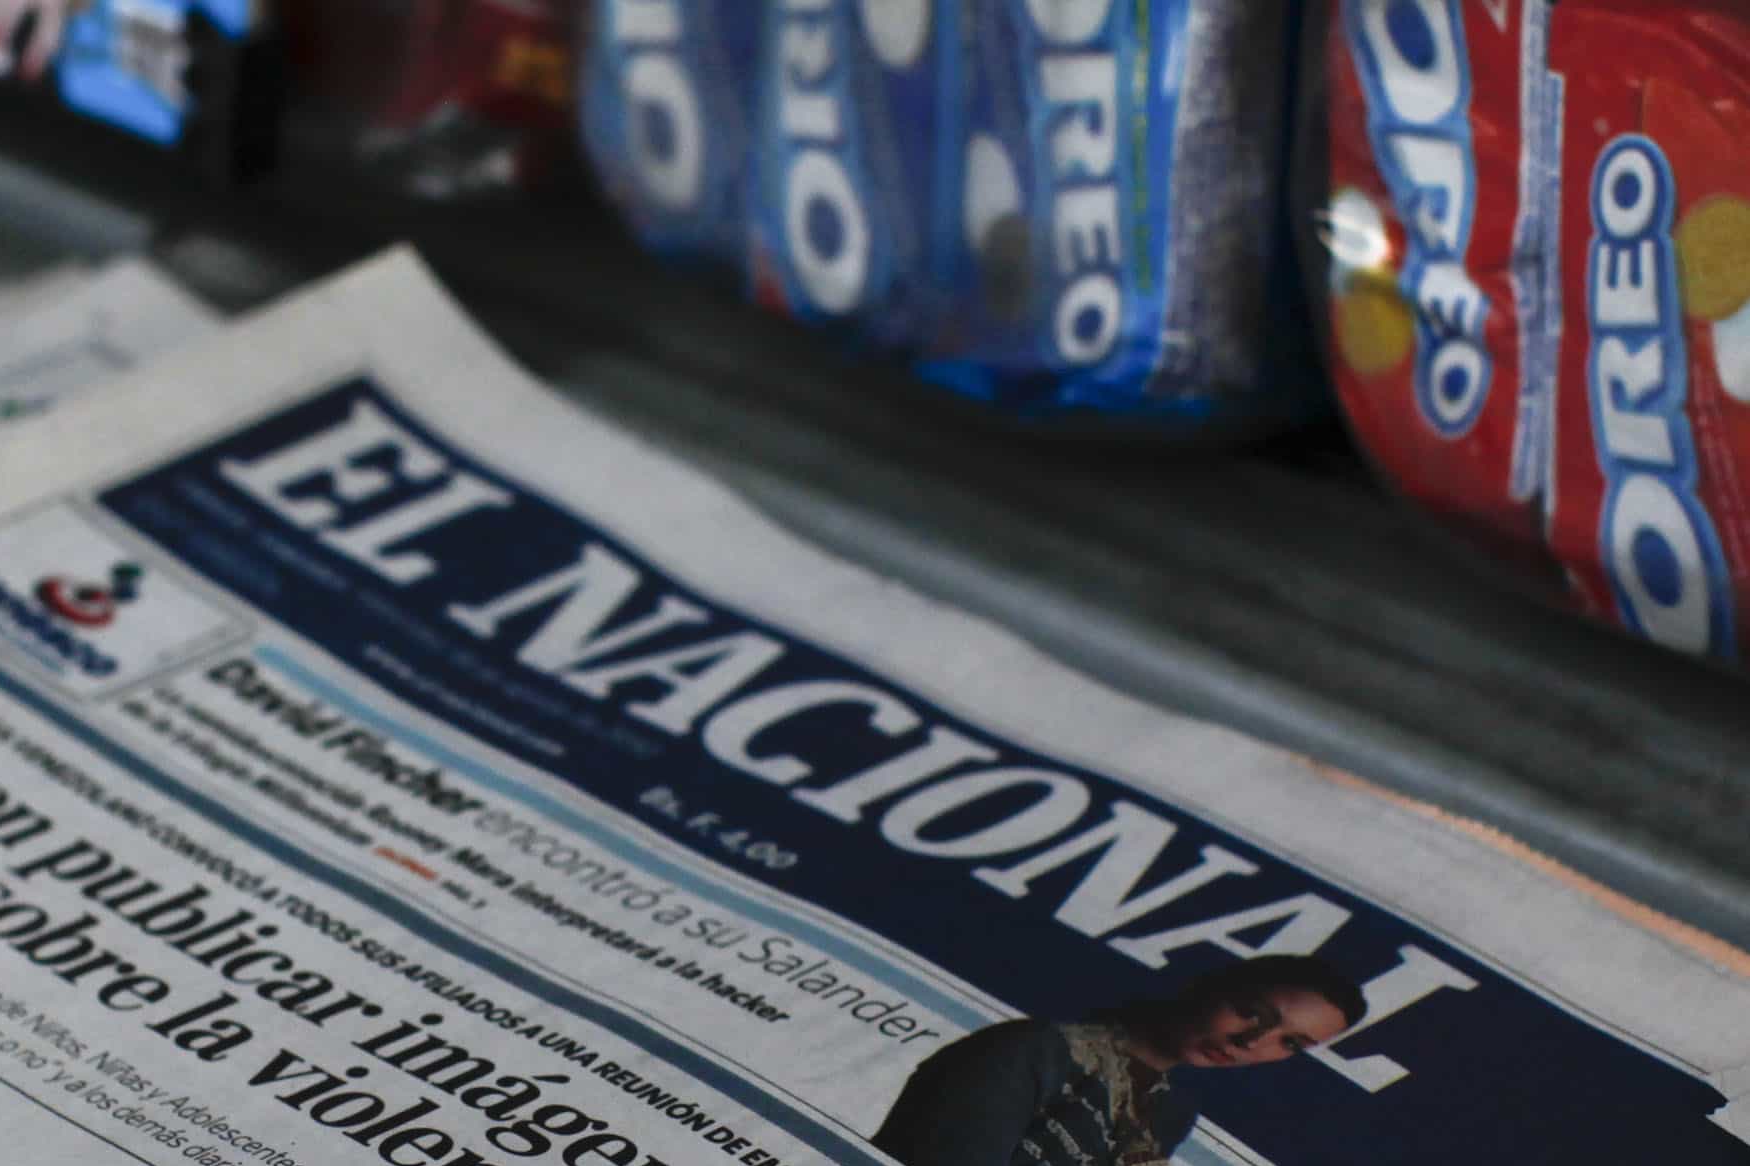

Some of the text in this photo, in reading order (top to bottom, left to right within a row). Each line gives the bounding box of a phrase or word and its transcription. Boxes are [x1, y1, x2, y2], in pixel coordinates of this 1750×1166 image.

[1595, 146, 1712, 655] OREO
[219, 400, 518, 587] EL
[447, 543, 1480, 1095] NACIONAL
[10, 838, 384, 1026] publicar
[449, 846, 516, 890] Mara
[509, 881, 671, 972] interpretará
[656, 956, 677, 975] a
[672, 958, 706, 983] la
[697, 970, 791, 1025] hacker
[475, 808, 674, 913] encontró
[654, 902, 686, 928] a
[683, 911, 750, 950] su
[738, 934, 940, 1048] Salander
[46, 1070, 75, 1095] y
[63, 1079, 85, 1096] a
[79, 1085, 118, 1113] los
[112, 1099, 187, 1150] demás
[84, 1046, 146, 1095] Niñas
[141, 1088, 169, 1112] y
[146, 990, 254, 1063] la
[276, 894, 362, 943] TODOS
[351, 938, 407, 969] SUS
[398, 963, 526, 1031] AFILIADOS
[514, 1025, 538, 1040] A
[538, 1033, 600, 1069] UNA
[591, 1061, 716, 1132] REUNIÓN
[703, 1126, 752, 1156] DE
